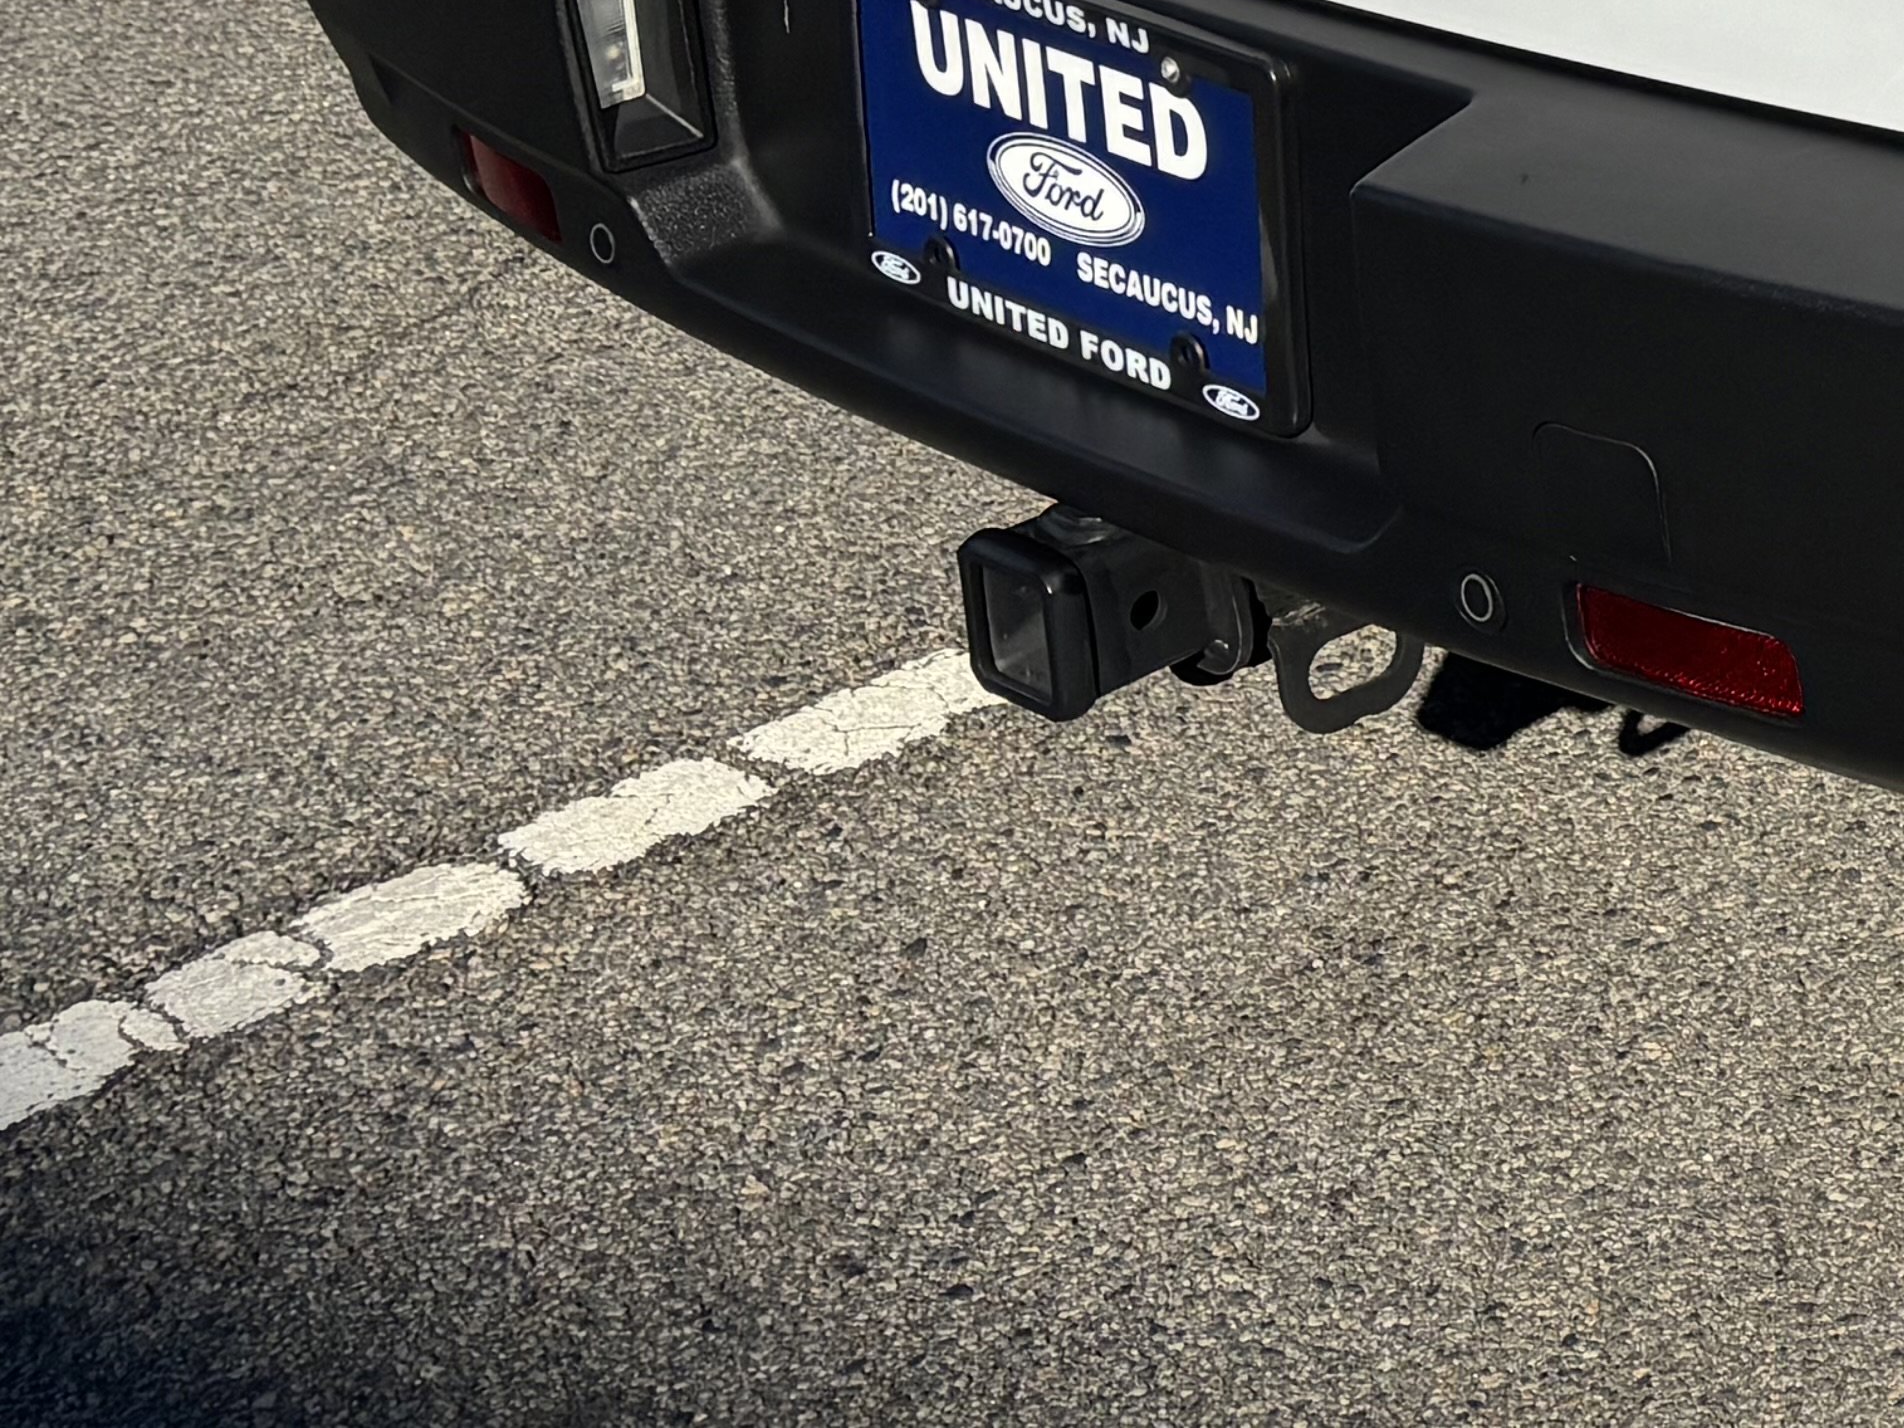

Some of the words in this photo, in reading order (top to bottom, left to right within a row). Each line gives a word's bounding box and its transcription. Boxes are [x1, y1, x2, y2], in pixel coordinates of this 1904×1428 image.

[909, 0, 1208, 181] UNITED
[1105, 16, 1150, 54] NJ
[1021, 148, 1106, 225] Ford
[890, 177, 948, 229] (201)
[953, 204, 1053, 269] 617-0700
[1076, 249, 1220, 334] SECAUCUS,
[1225, 303, 1259, 346] NJ
[946, 275, 1069, 350] UNITED
[1079, 329, 1172, 391] FORD
